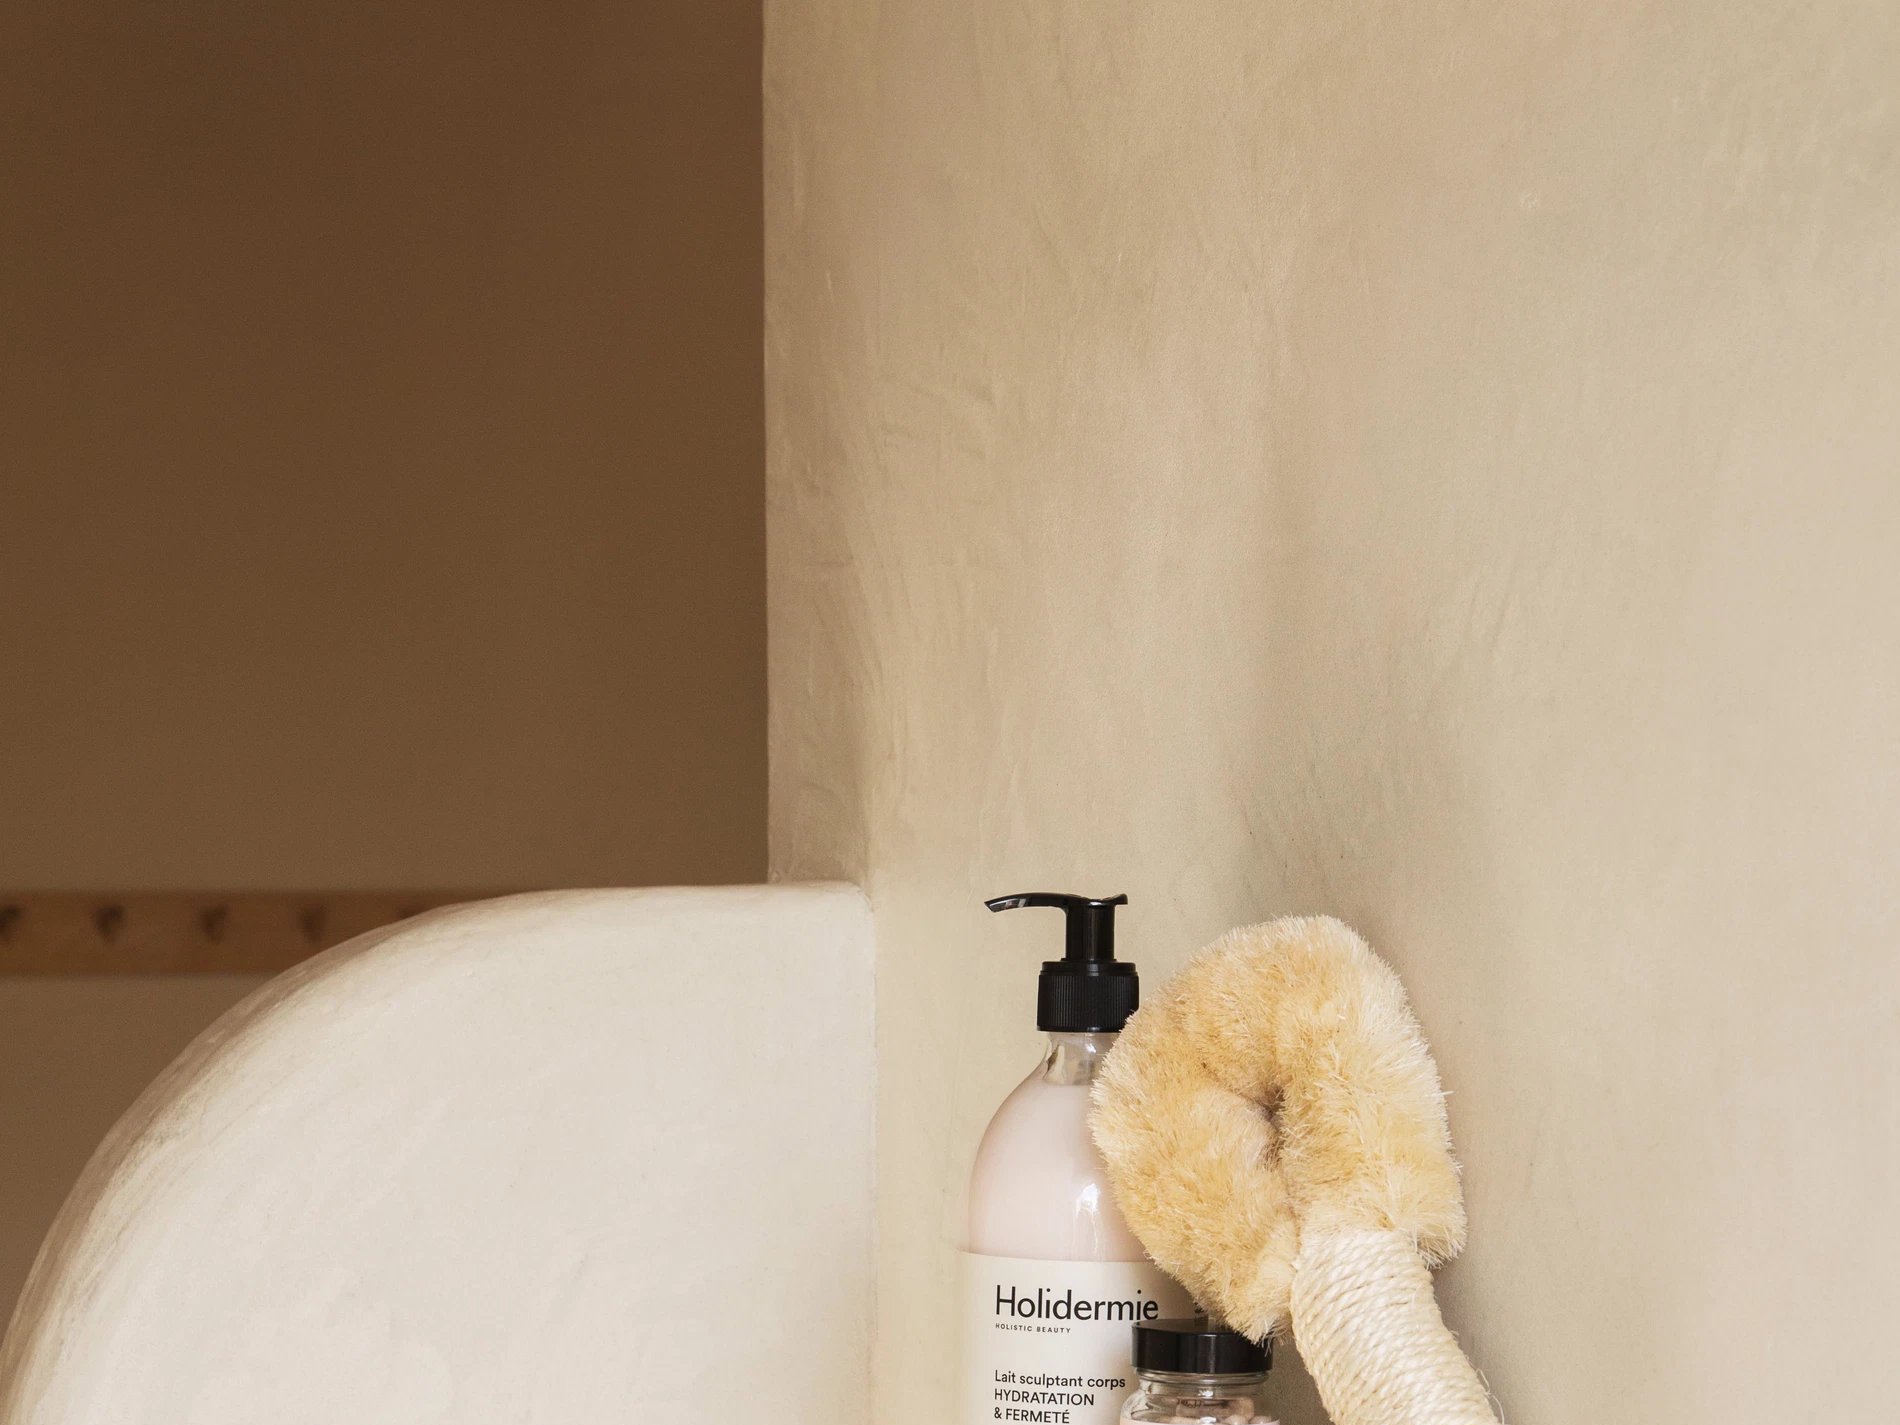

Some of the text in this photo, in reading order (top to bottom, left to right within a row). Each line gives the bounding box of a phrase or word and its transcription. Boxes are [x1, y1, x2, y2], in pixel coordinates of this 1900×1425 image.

[995, 1284, 1159, 1321] Holidermie
[995, 1323, 1033, 1332] HOLISTIC
[995, 1370, 1126, 1390] Lait sculptant corps
[994, 1389, 1095, 1406] HYDRATATION
[994, 1407, 1070, 1424] & FERMETÉ
